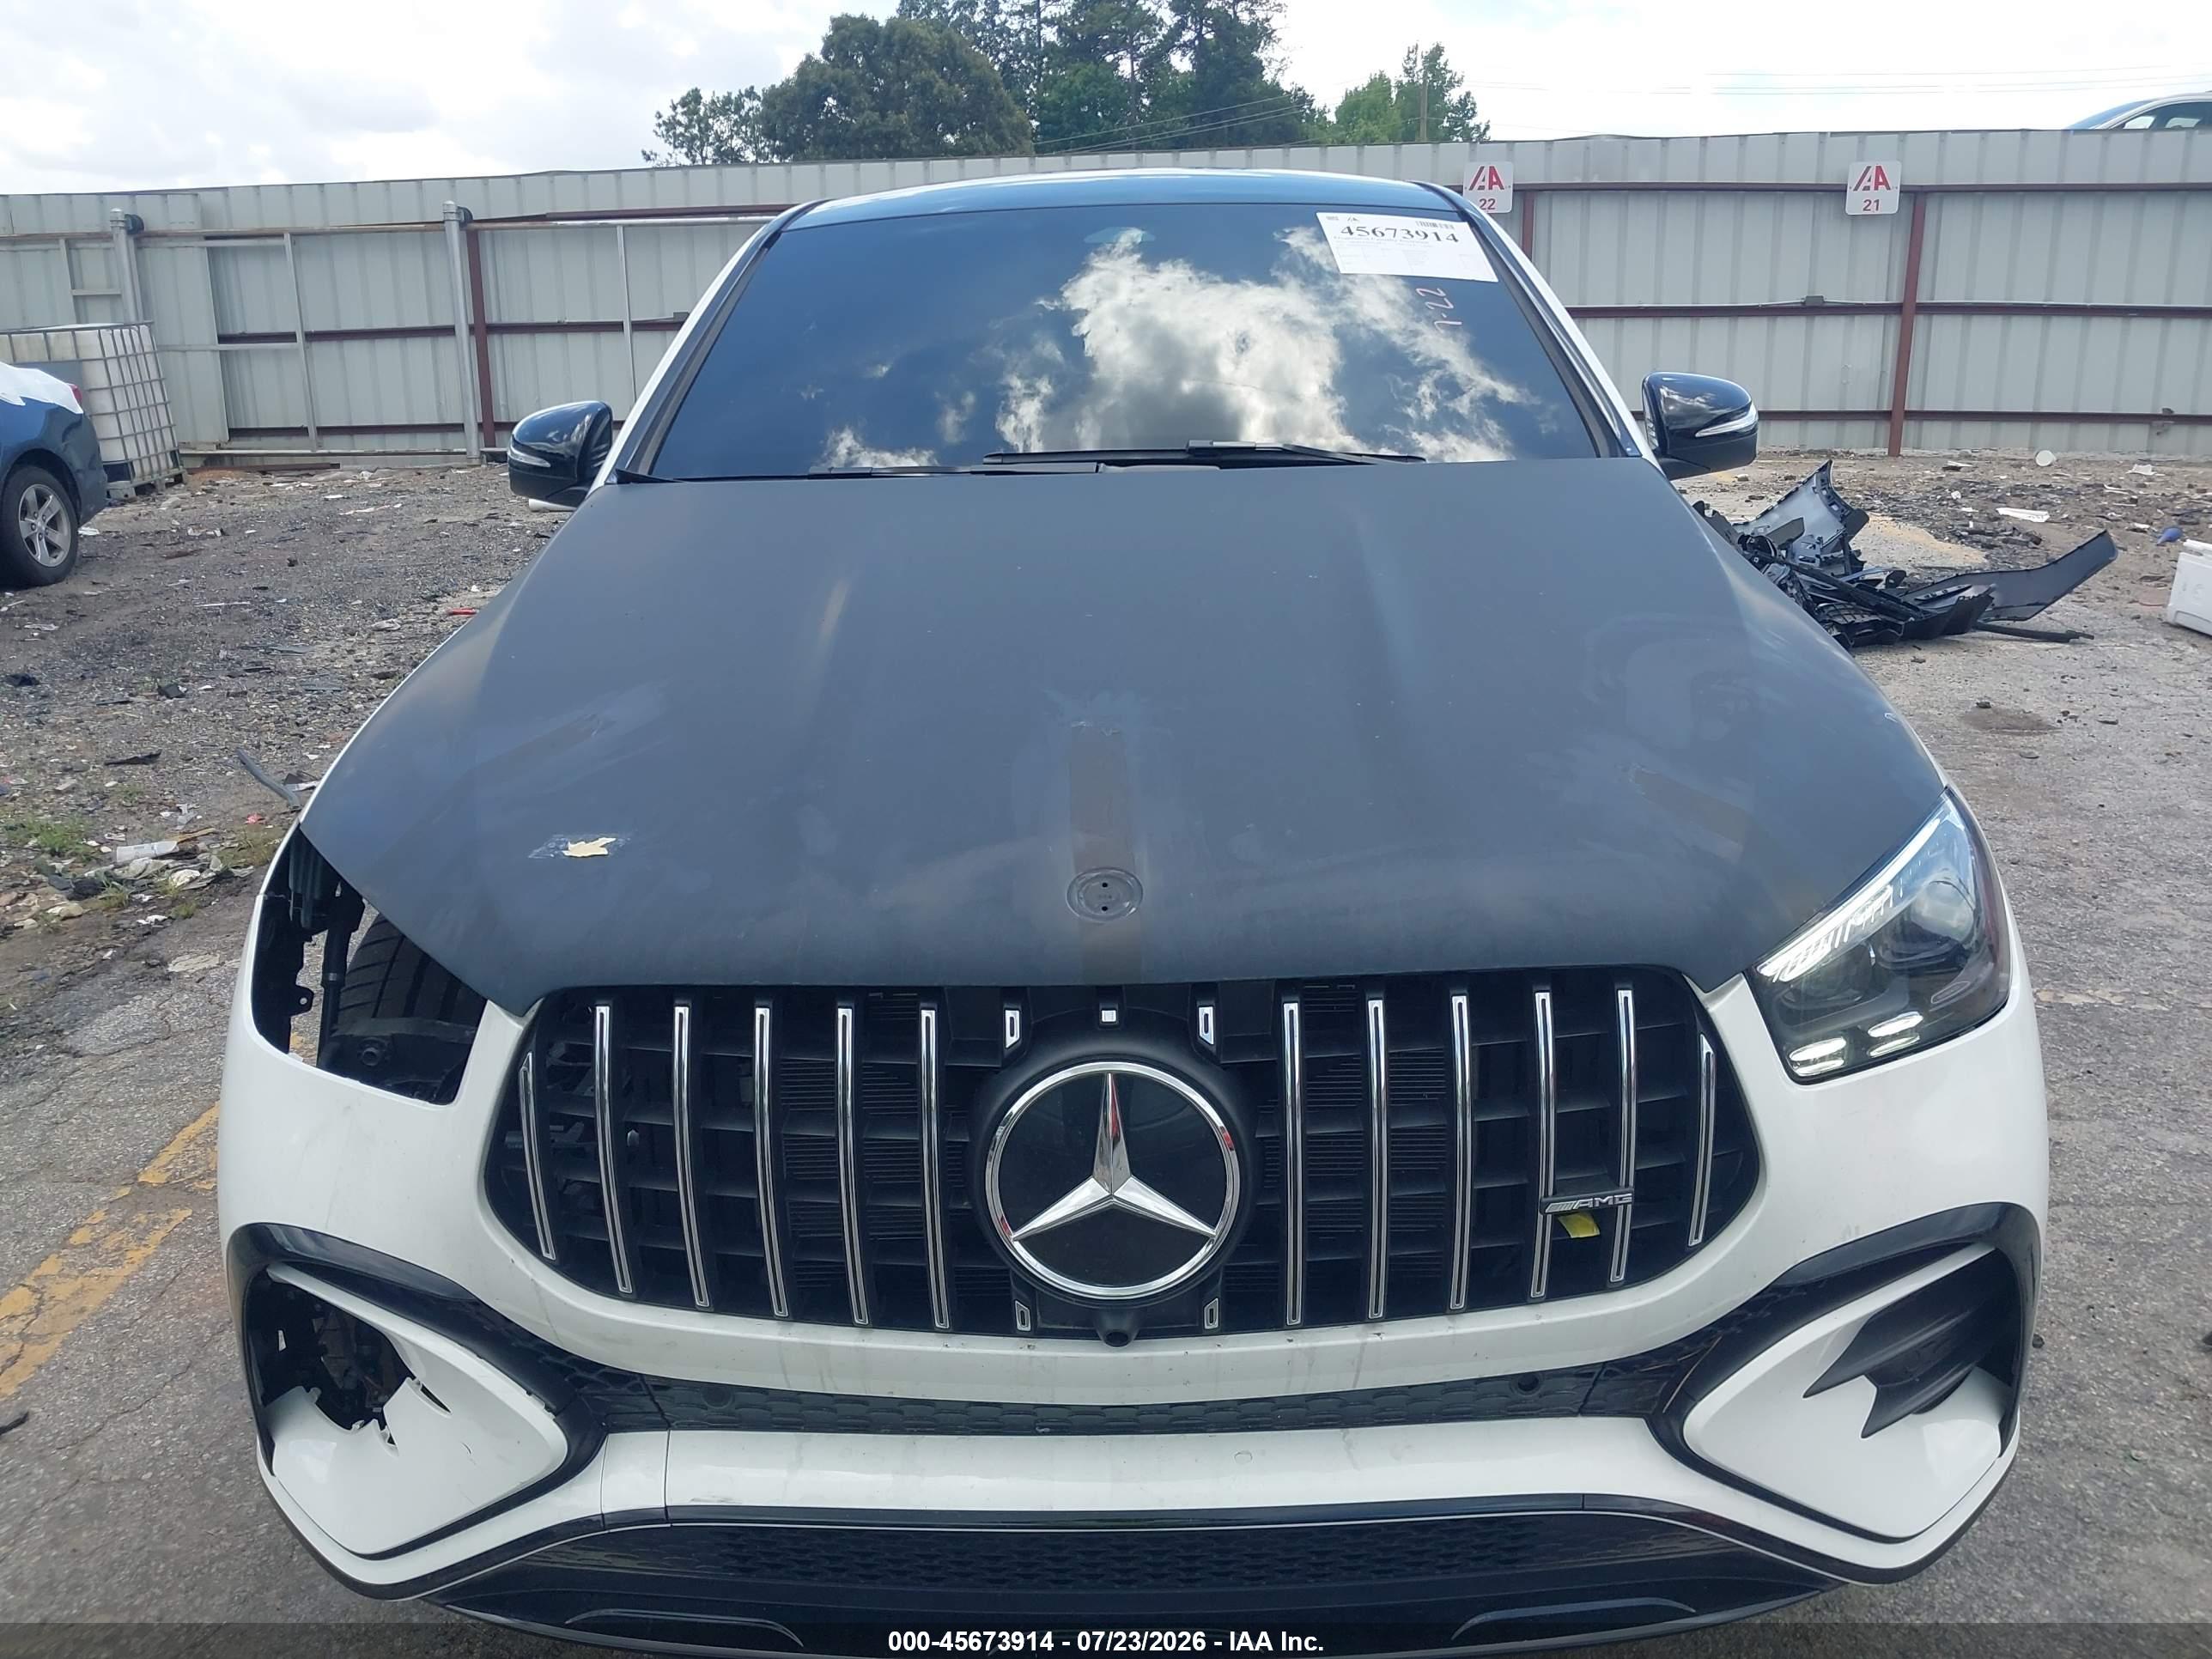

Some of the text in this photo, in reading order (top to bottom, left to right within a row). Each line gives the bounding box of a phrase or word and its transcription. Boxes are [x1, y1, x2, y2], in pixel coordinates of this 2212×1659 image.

[1479, 198, 1496, 210] 22
[1863, 199, 1880, 211] 21
[1340, 226, 1459, 243] 45673914
